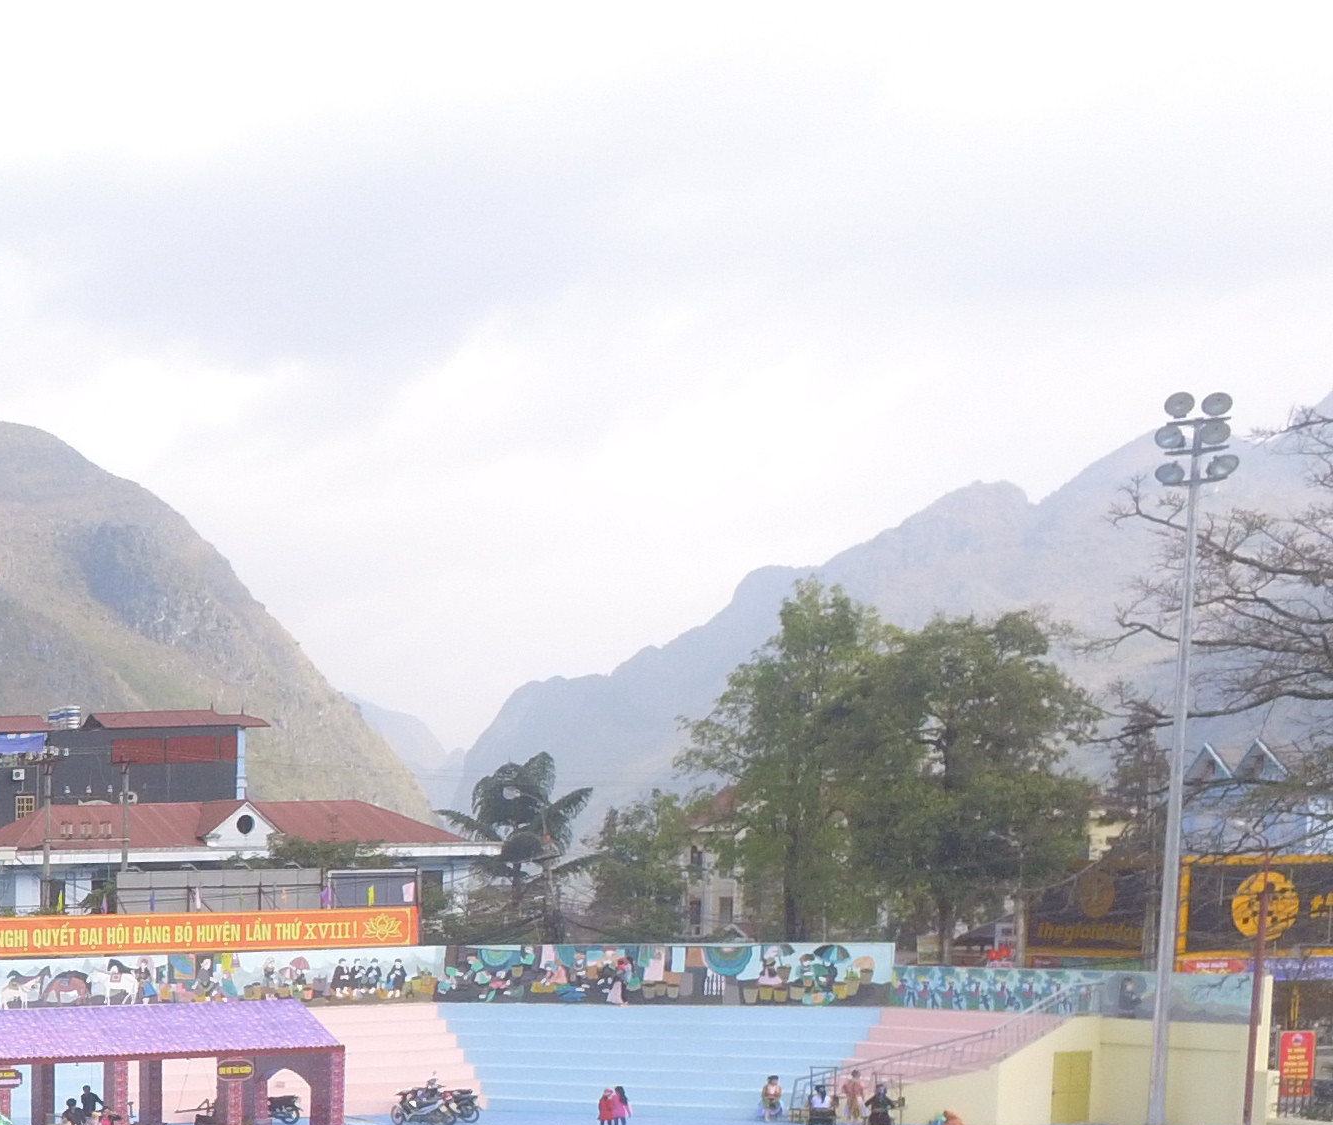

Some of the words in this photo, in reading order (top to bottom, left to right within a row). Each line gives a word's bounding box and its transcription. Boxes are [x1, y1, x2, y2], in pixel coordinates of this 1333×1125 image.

[32, 921, 77, 949] QUYẾT
[79, 927, 103, 950] ĐẠI
[106, 922, 130, 949] HỘI
[133, 918, 171, 945] ĐẢNG
[174, 921, 193, 947] BỘ
[196, 920, 241, 946] HUYỆN
[245, 917, 272, 942] LẦN
[274, 917, 303, 941] THỨ
